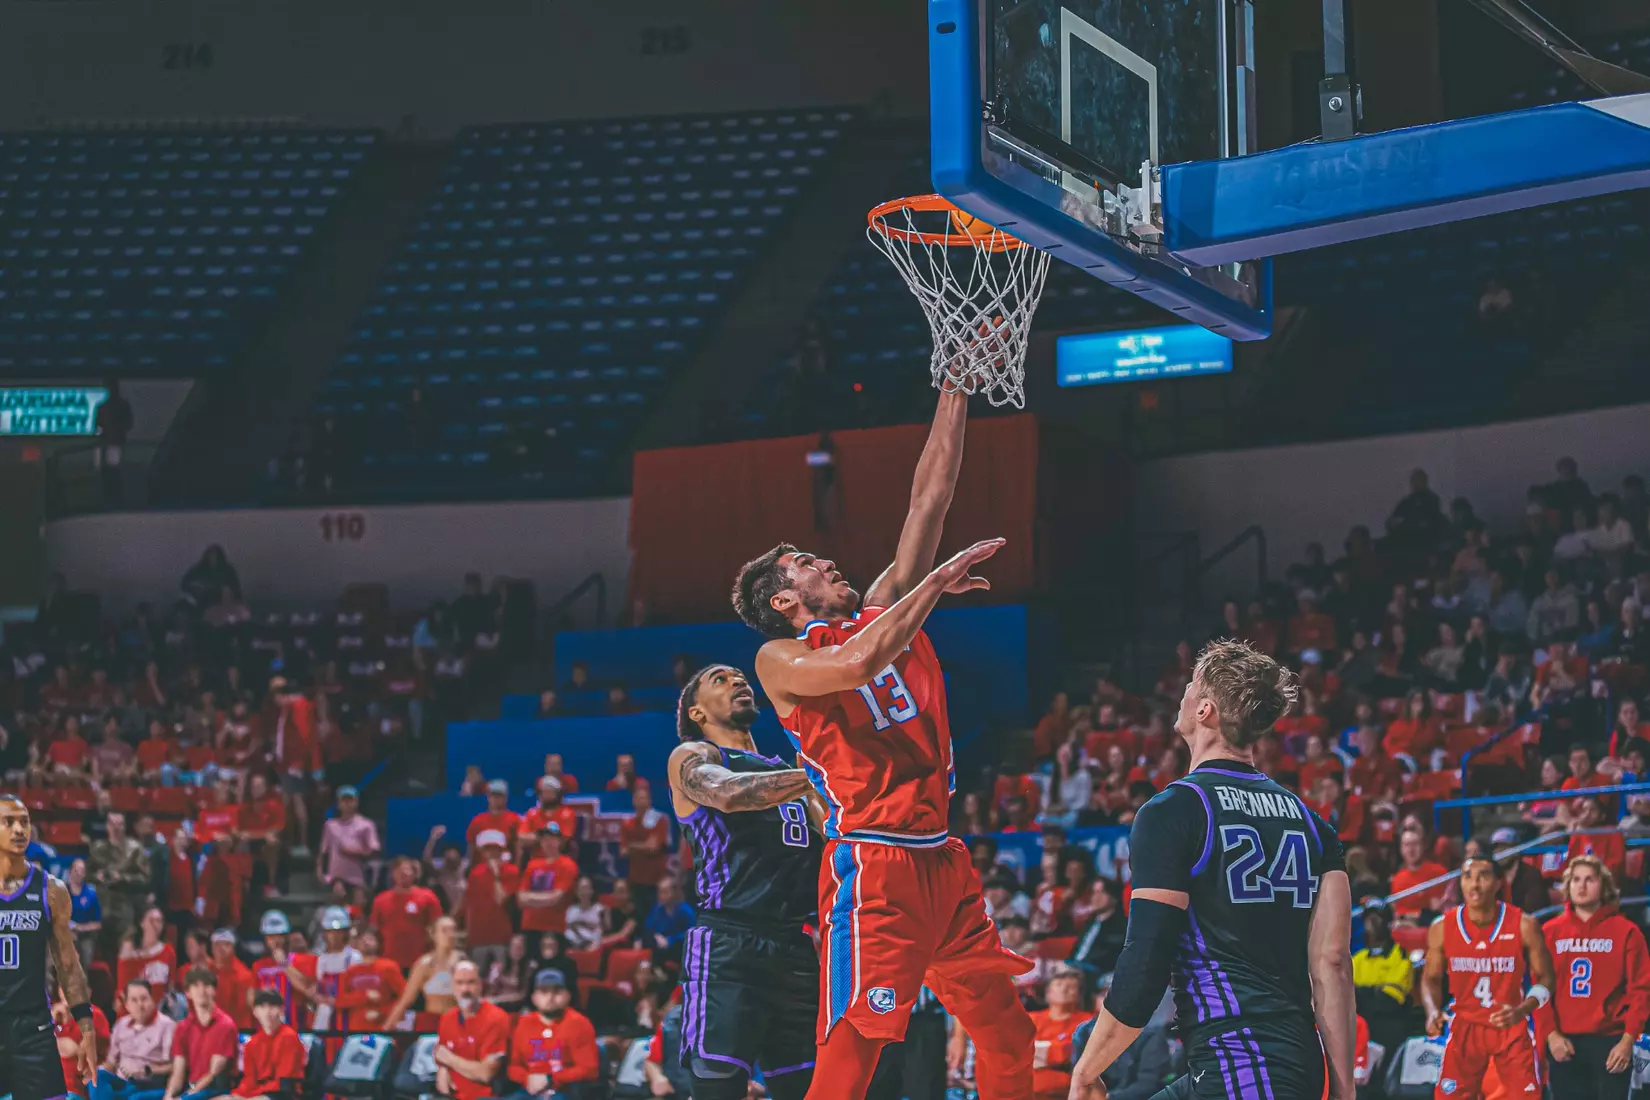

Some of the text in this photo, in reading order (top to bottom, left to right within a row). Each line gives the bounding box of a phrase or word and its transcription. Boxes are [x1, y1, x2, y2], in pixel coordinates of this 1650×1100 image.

[320, 512, 366, 541] 110
[855, 664, 919, 732] 13
[1214, 785, 1303, 820] BRENNAN
[778, 801, 809, 848] 8
[1218, 823, 1320, 909] 24
[1473, 976, 1493, 1008] 4
[1570, 957, 1593, 998] 2
